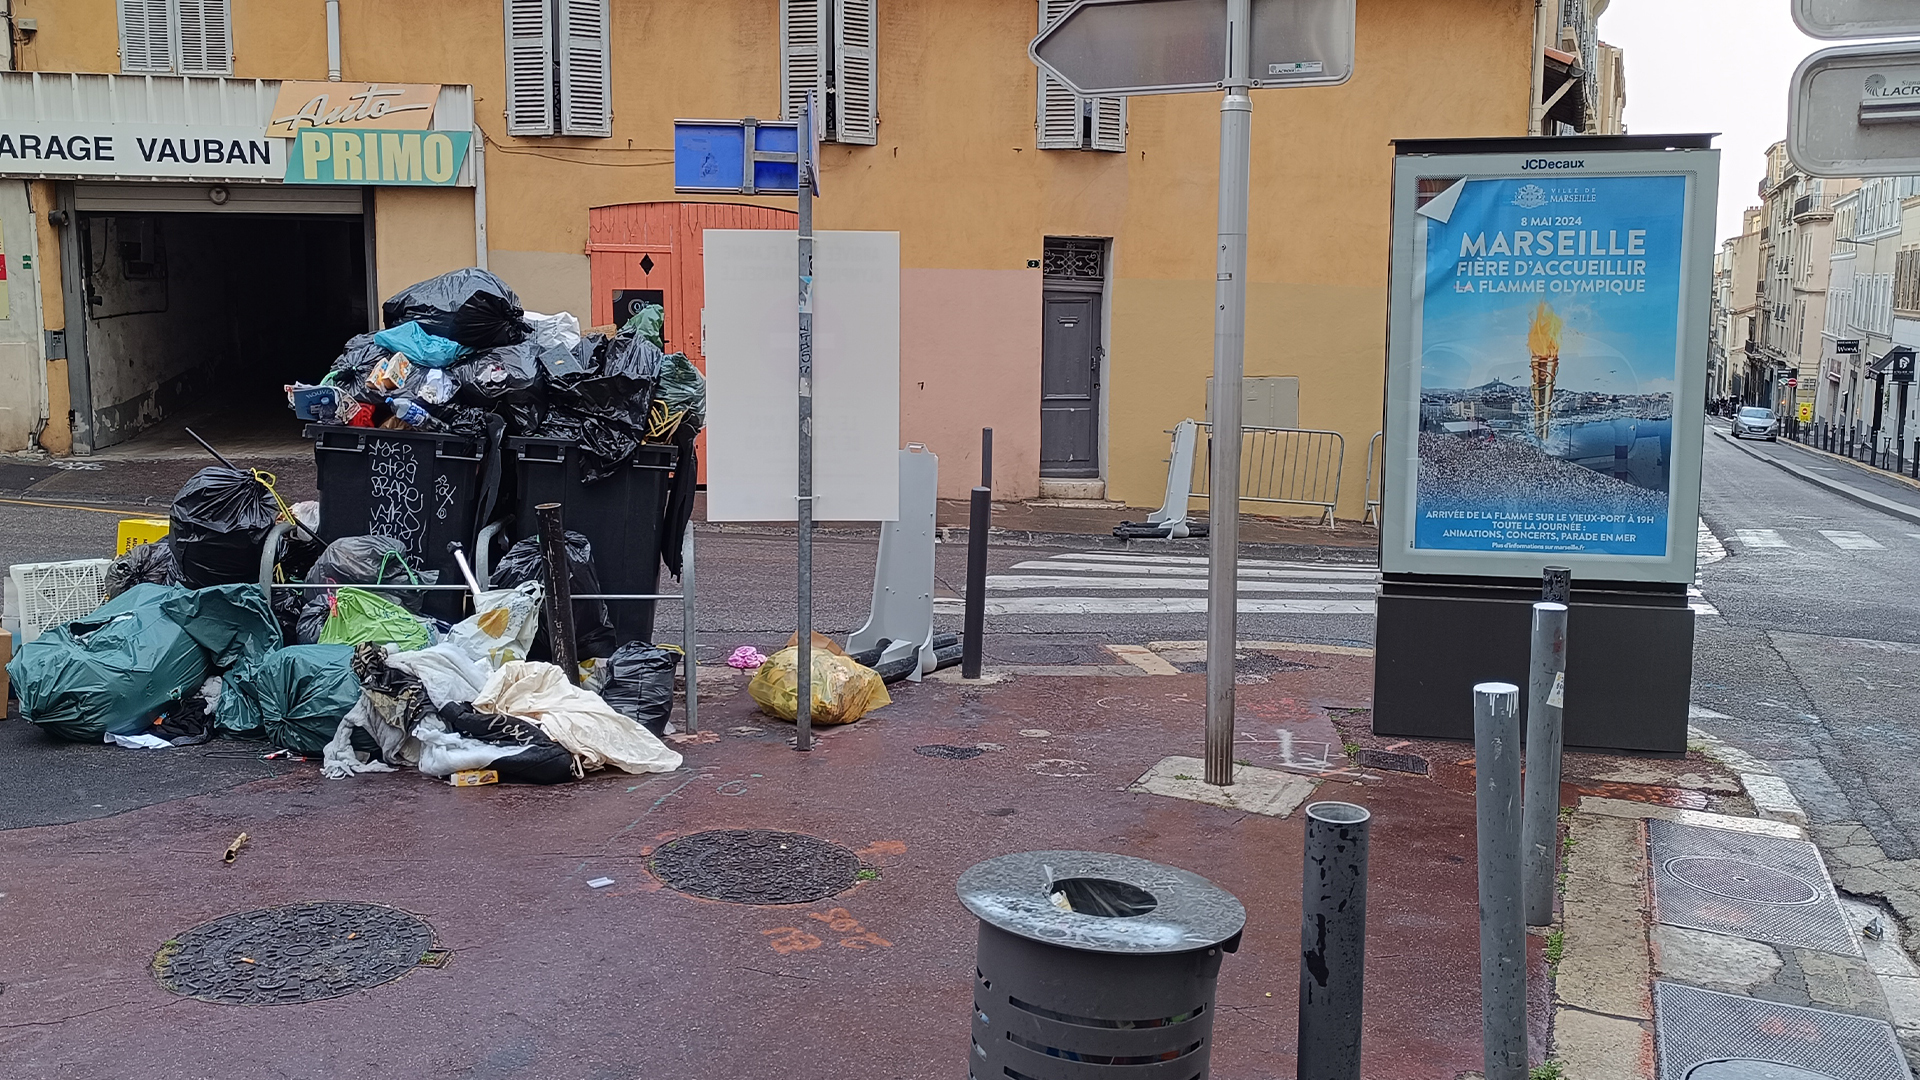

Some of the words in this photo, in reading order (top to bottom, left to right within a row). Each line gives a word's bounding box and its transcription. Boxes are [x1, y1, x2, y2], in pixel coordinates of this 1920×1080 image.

[273, 84, 432, 131] Auto
[136, 136, 272, 165] VAUBAN
[302, 131, 454, 183] PRIMO
[1521, 158, 1585, 170] JCDecaux
[1550, 194, 1597, 203] MARSEILLE
[1520, 217, 1528, 226] 8
[1530, 217, 1552, 226] MAI
[1554, 216, 1583, 226] 2024
[1459, 229, 1647, 257] MARSEILLE
[1456, 256, 1509, 276] FIÈRE
[1455, 280, 1475, 293] LA
[1479, 280, 1545, 293] FLAMME
[1549, 279, 1646, 295] OLYMPIQUE
[1425, 510, 1466, 519] ARRIVÉE
[1466, 511, 1479, 519] DE
[1481, 511, 1493, 520] LA
[1494, 512, 1534, 521] FLAMME
[1535, 513, 1554, 521] SUR
[1556, 514, 1567, 522] LE
[1569, 514, 1626, 523] VIEUX-PORT
[1627, 513, 1635, 523] À
[1637, 515, 1654, 524] 19H
[1491, 521, 1522, 530] TOUTE
[1524, 522, 1536, 530] LA
[1537, 521, 1581, 531] JOURNÉE
[1442, 529, 1504, 539] ANIMATIONS,
[1506, 531, 1559, 541] CONCERTS,
[1561, 532, 1598, 541] PARADE
[1600, 533, 1613, 541] EN
[1615, 533, 1637, 542] MER
